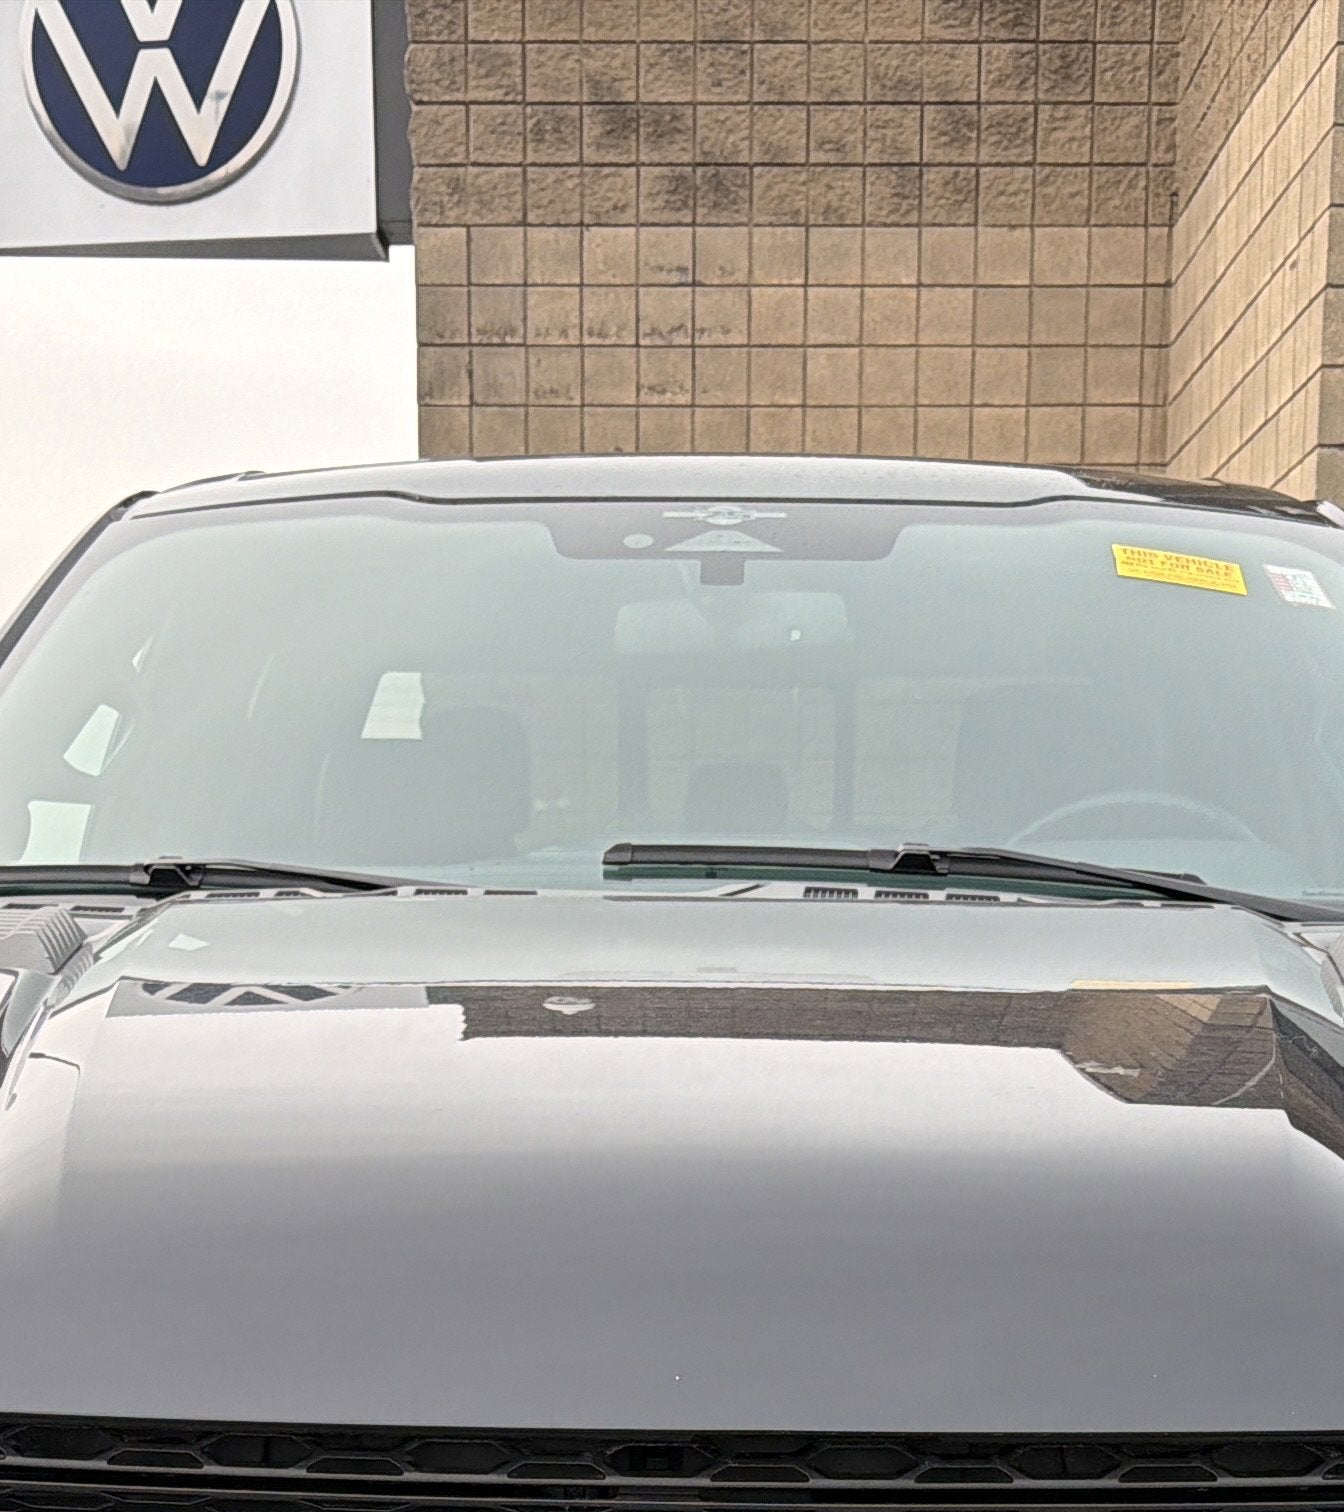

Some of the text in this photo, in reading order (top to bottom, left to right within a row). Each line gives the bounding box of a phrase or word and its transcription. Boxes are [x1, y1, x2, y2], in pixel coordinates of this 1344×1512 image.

[1122, 548, 1159, 559] THIS
[1164, 554, 1234, 572] VEHICLE
[1126, 556, 1155, 566] NOT
[1160, 560, 1190, 571] FOR
[1196, 566, 1233, 577] SALE
